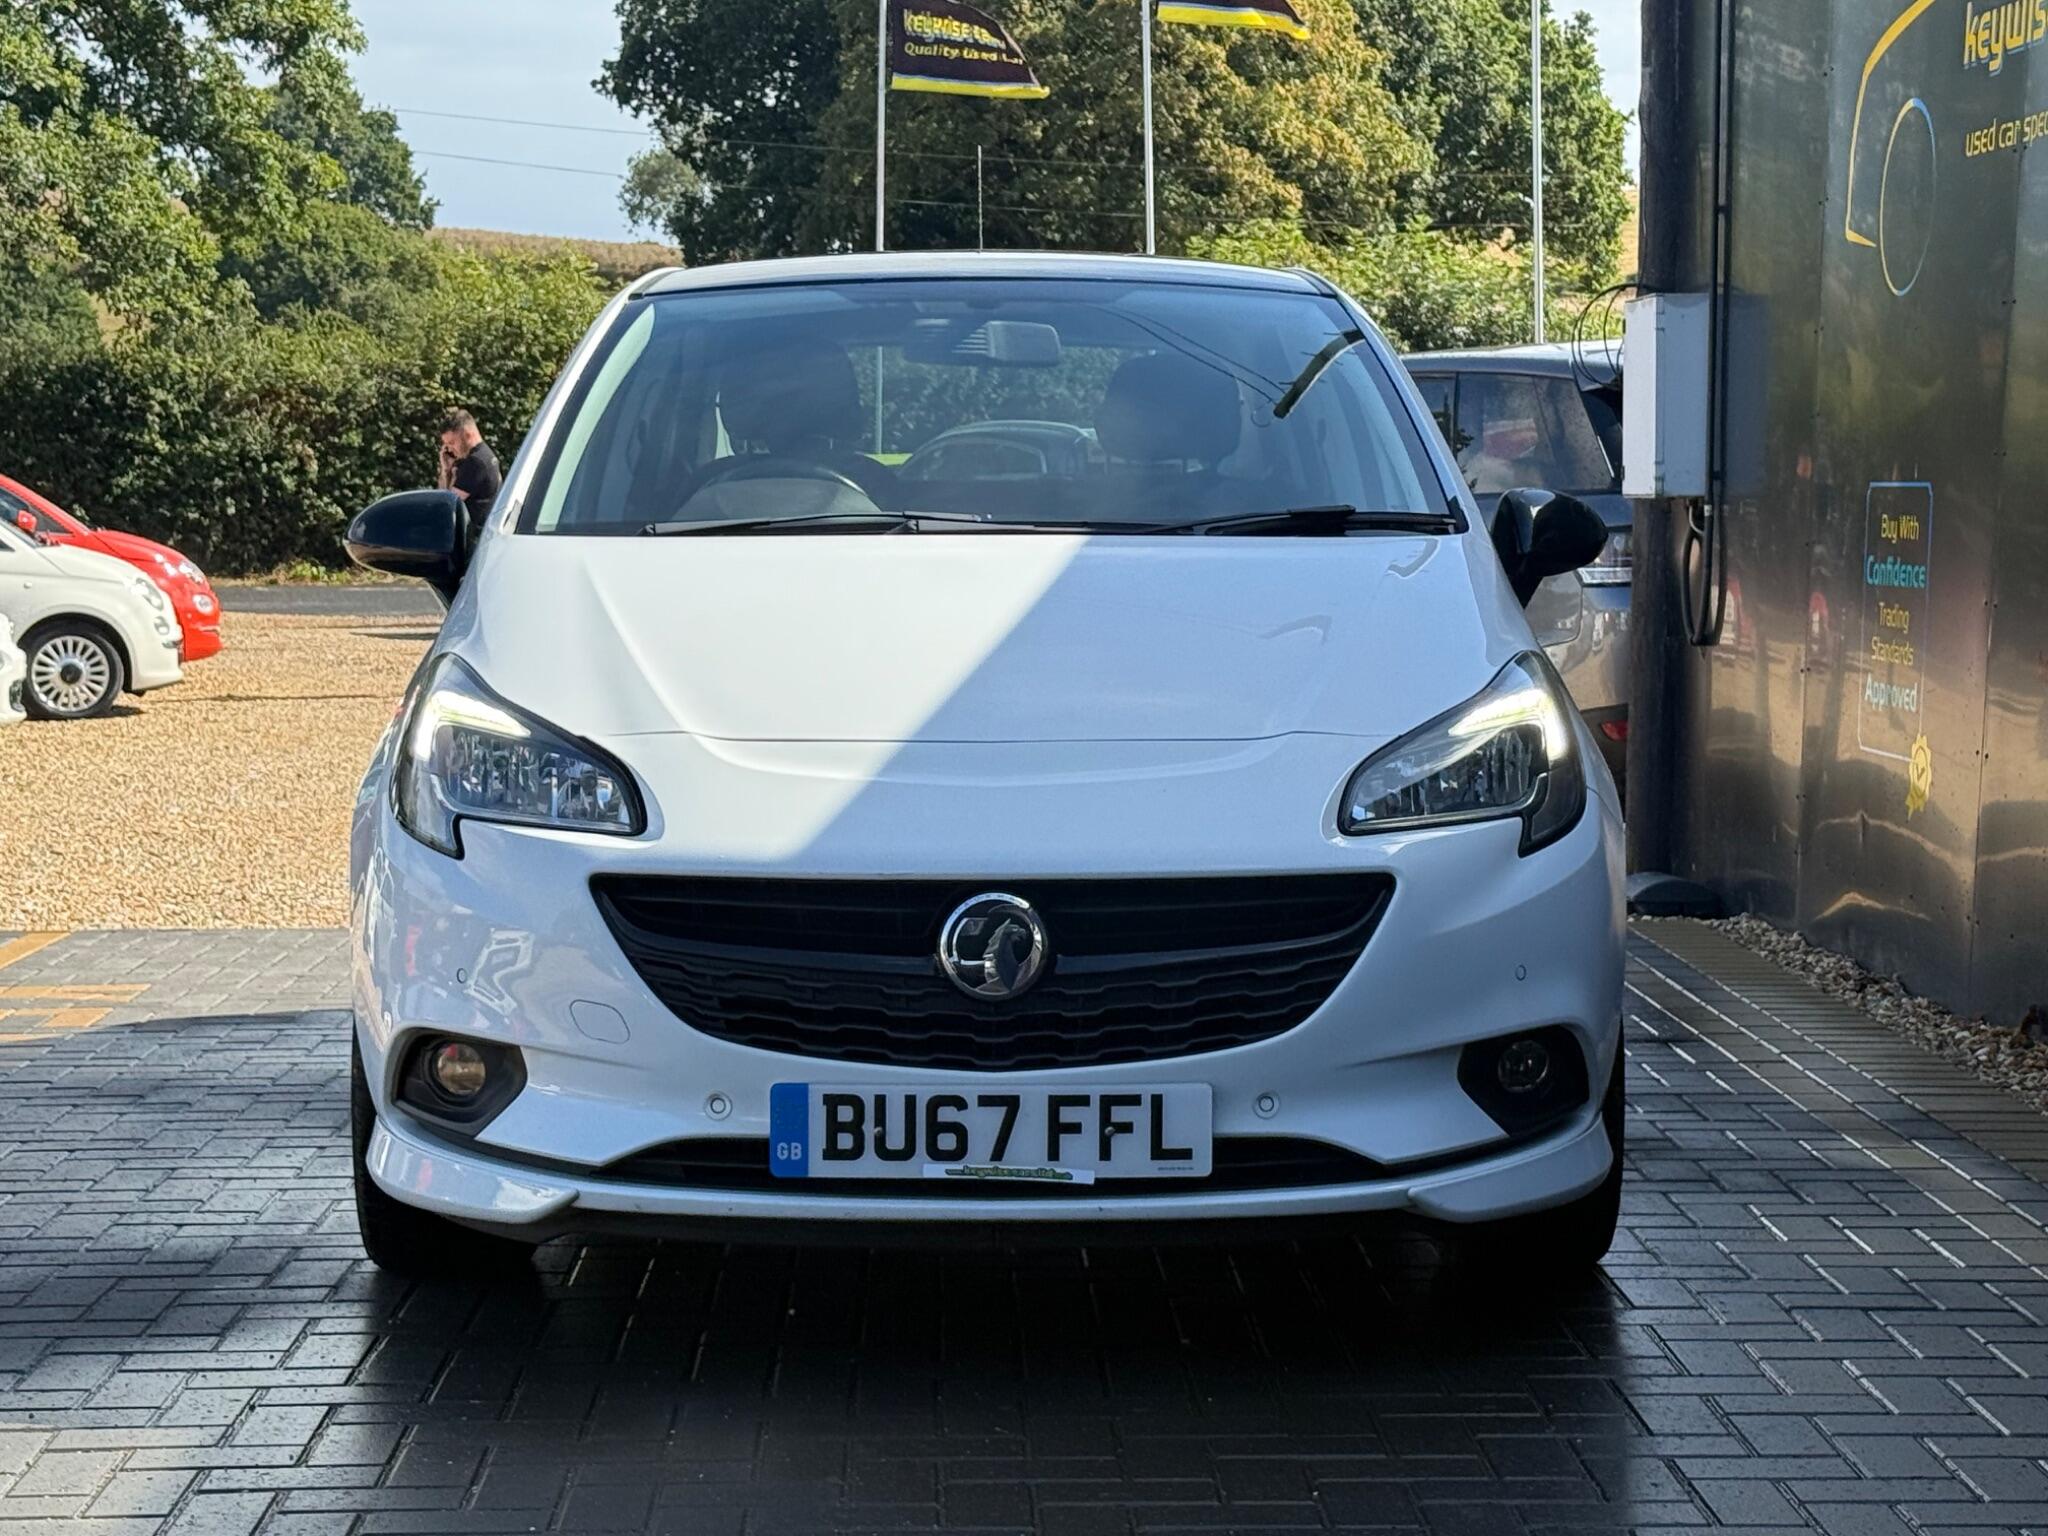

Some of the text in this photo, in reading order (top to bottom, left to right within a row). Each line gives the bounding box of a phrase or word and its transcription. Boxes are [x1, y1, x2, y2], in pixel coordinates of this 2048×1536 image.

[904, 42, 959, 59] Quality
[1963, 0, 2048, 76] keywis
[1966, 118, 1997, 157] used
[1999, 120, 2021, 148] car
[1881, 513, 1919, 544] Buy With
[1867, 555, 1926, 588] Confidence
[1879, 601, 1910, 634] Trading
[1871, 636, 1914, 665] Standards
[1865, 672, 1918, 713] Approved
[821, 1093, 1193, 1162] BU67 FFL
[777, 1142, 802, 1160] GB
